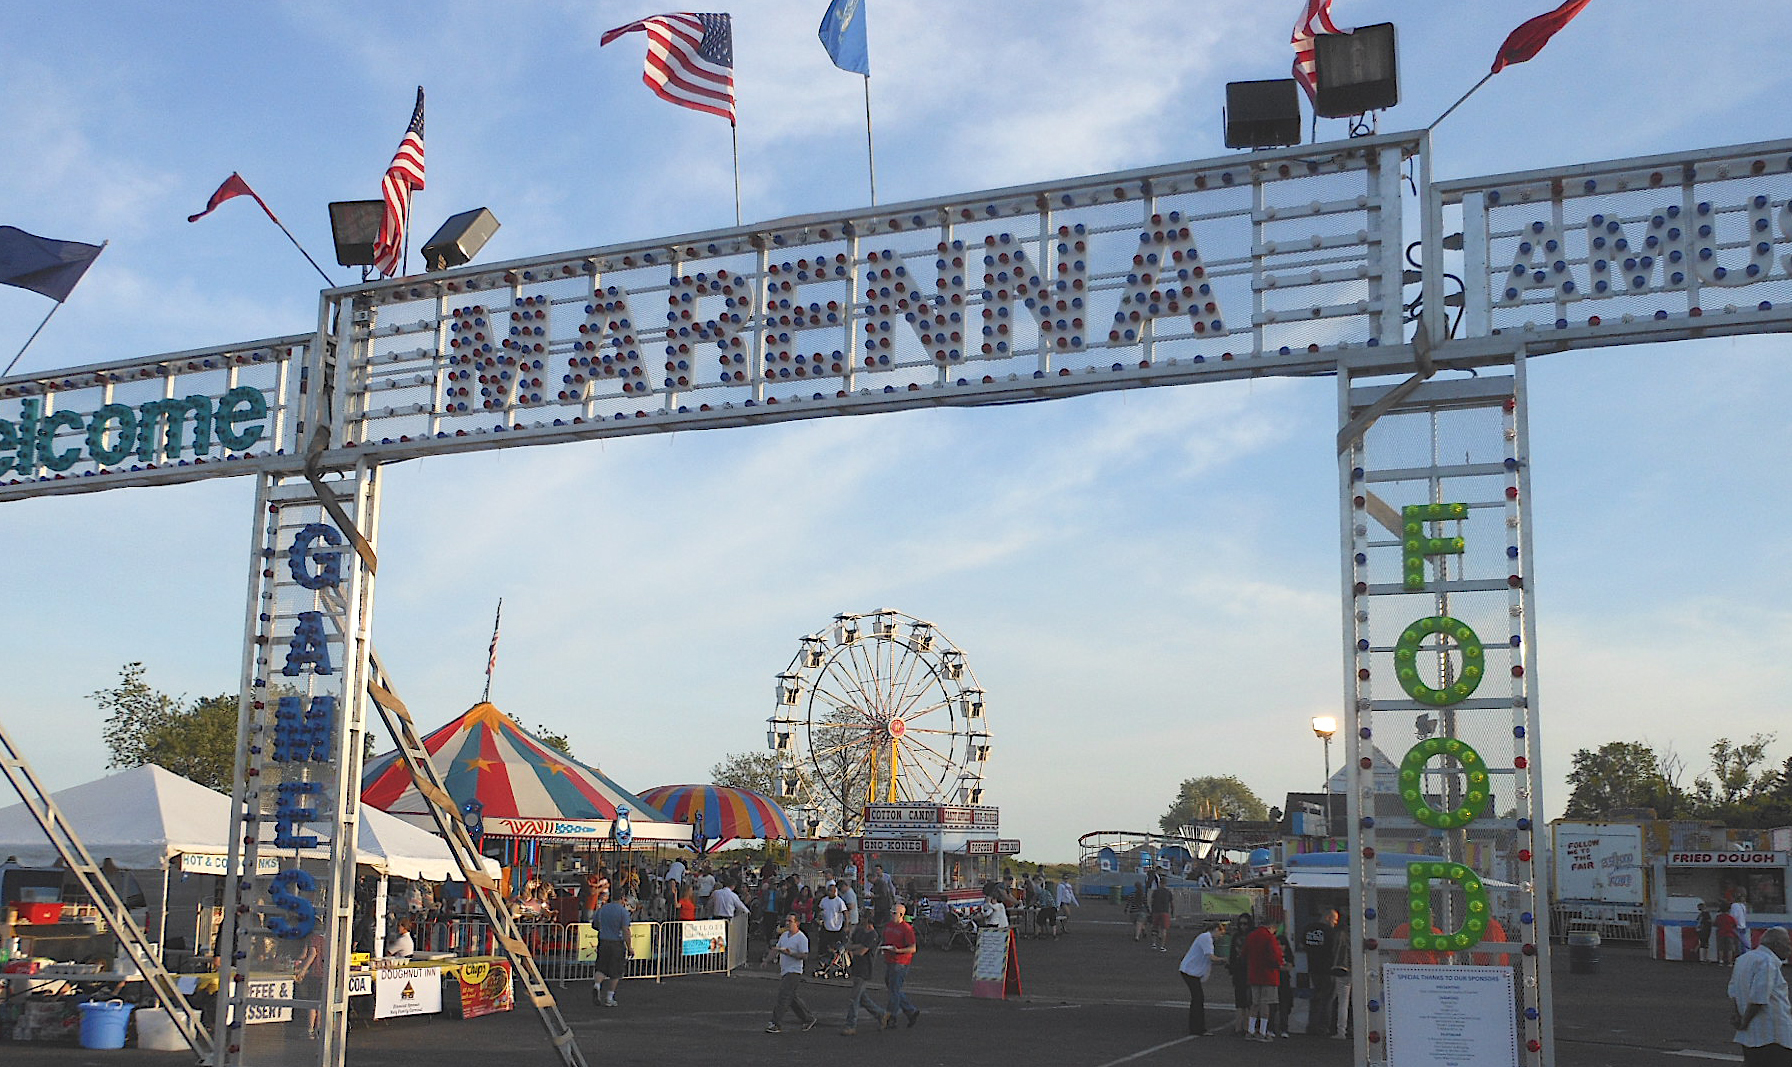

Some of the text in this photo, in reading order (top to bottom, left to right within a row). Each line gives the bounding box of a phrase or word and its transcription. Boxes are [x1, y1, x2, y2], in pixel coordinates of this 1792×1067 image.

[446, 211, 1230, 415] MARENNA
[268, 523, 343, 940] GAMES
[1394, 503, 1490, 951] FOOD
[871, 809, 935, 821] COTTON CANDY
[864, 841, 921, 850] SNO-KONES
[1567, 839, 1600, 849] FOLLOW
[183, 855, 203, 866] HOT
[206, 857, 212, 867] &
[1673, 854, 1775, 863] FRIED DOUGH
[1571, 861, 1595, 871] FAIR
[381, 967, 437, 980] DOUGHNUT INN
[280, 982, 288, 997] &
